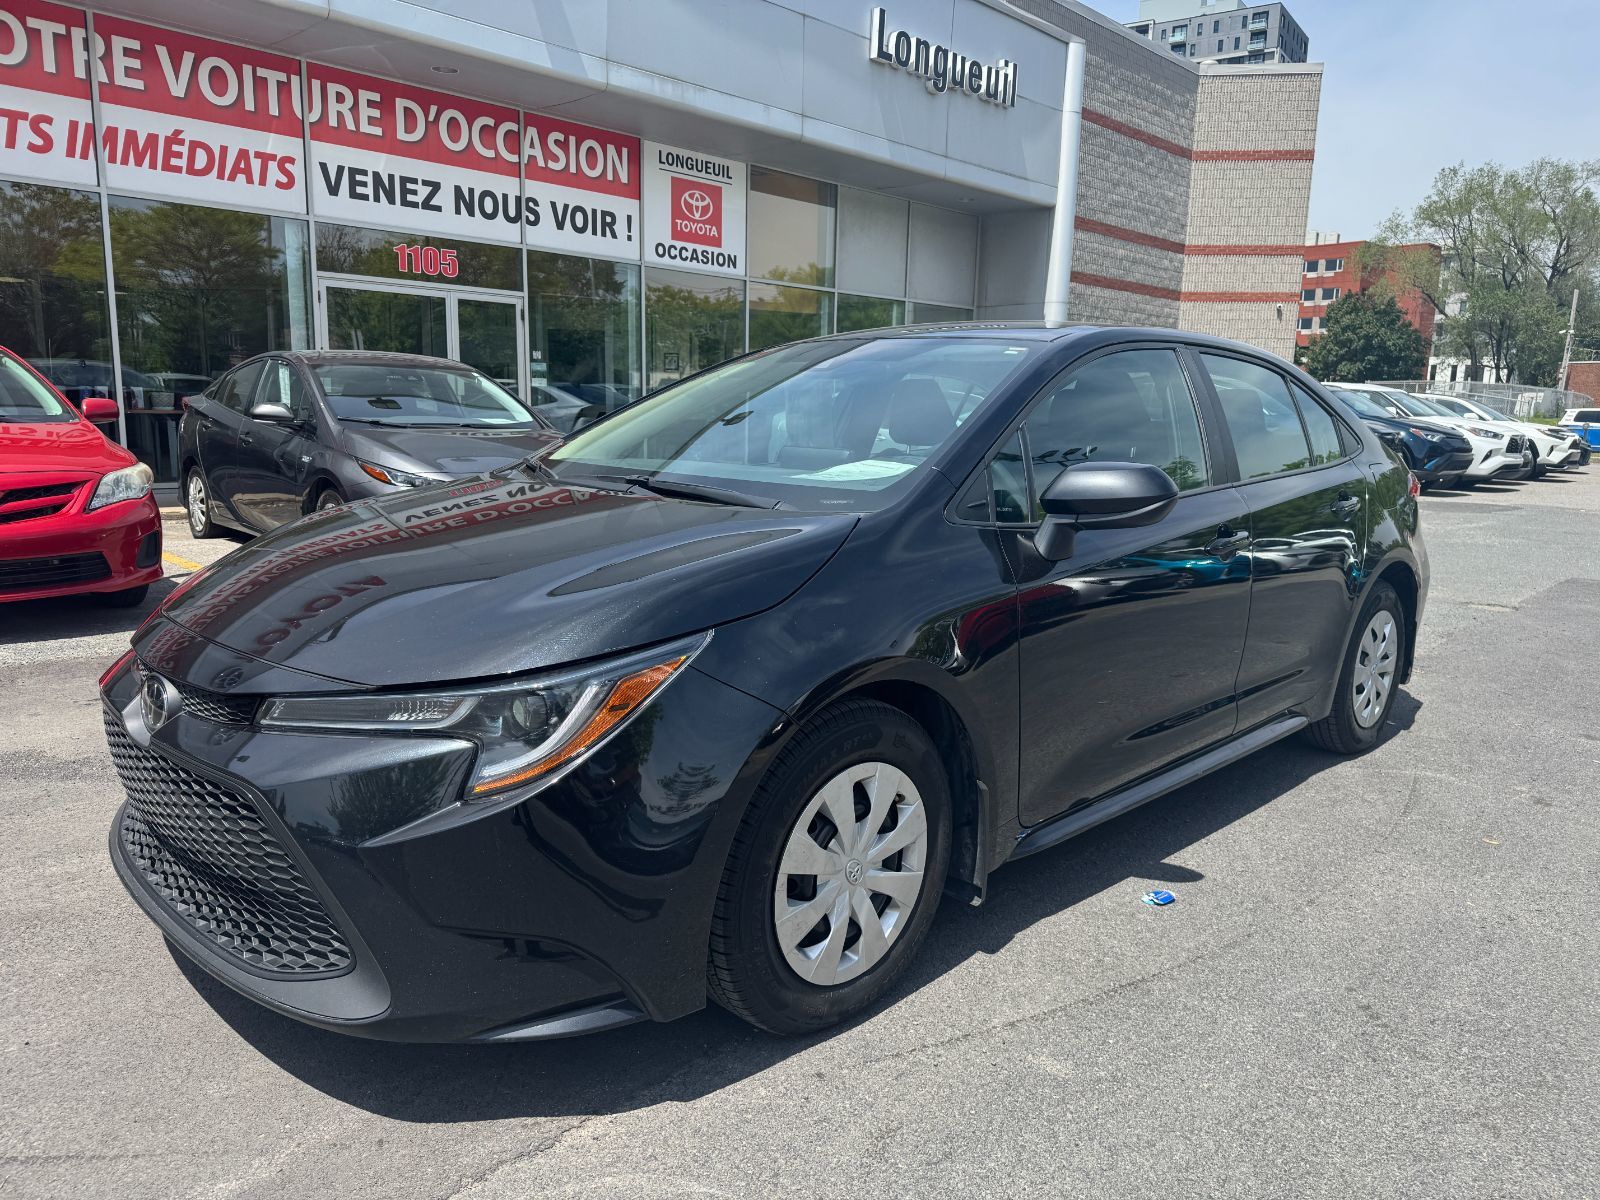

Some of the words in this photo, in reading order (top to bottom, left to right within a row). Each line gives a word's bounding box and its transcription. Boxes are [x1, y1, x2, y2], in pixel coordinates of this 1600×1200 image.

[870, 7, 1018, 107] Longueuil
[155, 44, 383, 137] VOITURE
[395, 97, 629, 184] D'OCCASION
[65, 119, 297, 191] IMMÉDIATS
[658, 150, 733, 180] LONGUEUIL
[318, 161, 443, 213] VENEZ
[454, 184, 541, 227] NOUS
[550, 201, 618, 239] VOIR
[675, 219, 719, 238] TOYOTA
[393, 243, 459, 278] 1105
[655, 242, 737, 269] OCCASION
